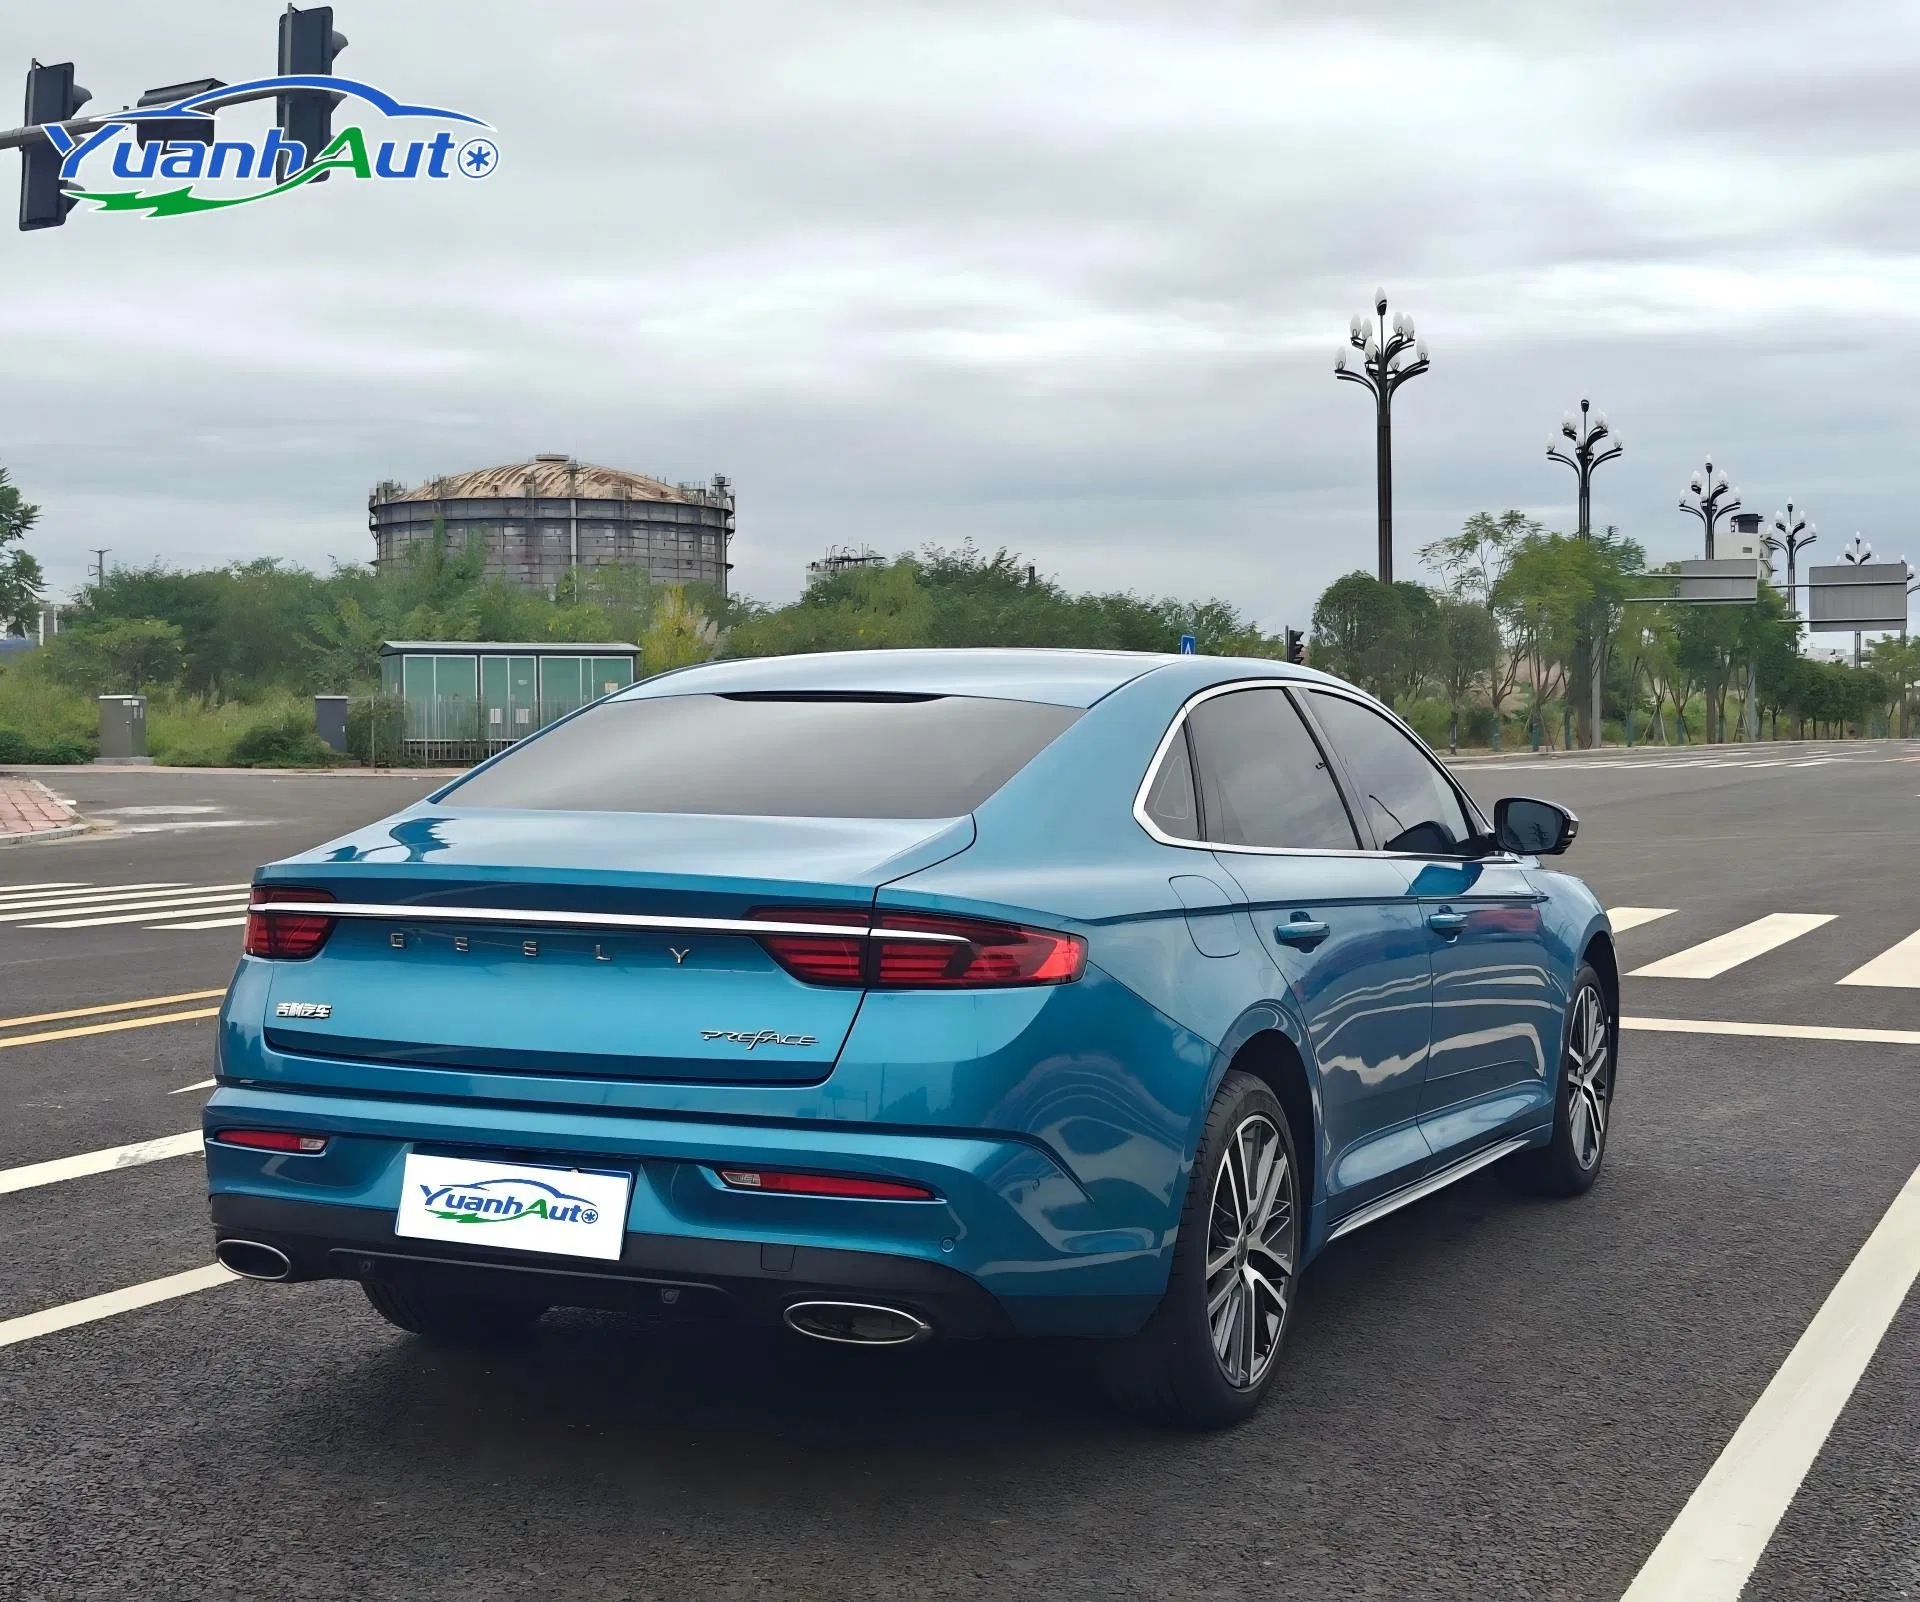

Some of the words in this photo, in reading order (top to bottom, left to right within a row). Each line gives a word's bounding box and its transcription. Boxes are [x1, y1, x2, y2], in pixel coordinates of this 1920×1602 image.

[390, 932, 691, 965] GEELY
[276, 1002, 333, 1019] 吉利汽车
[700, 1029, 820, 1051] PREFACE
